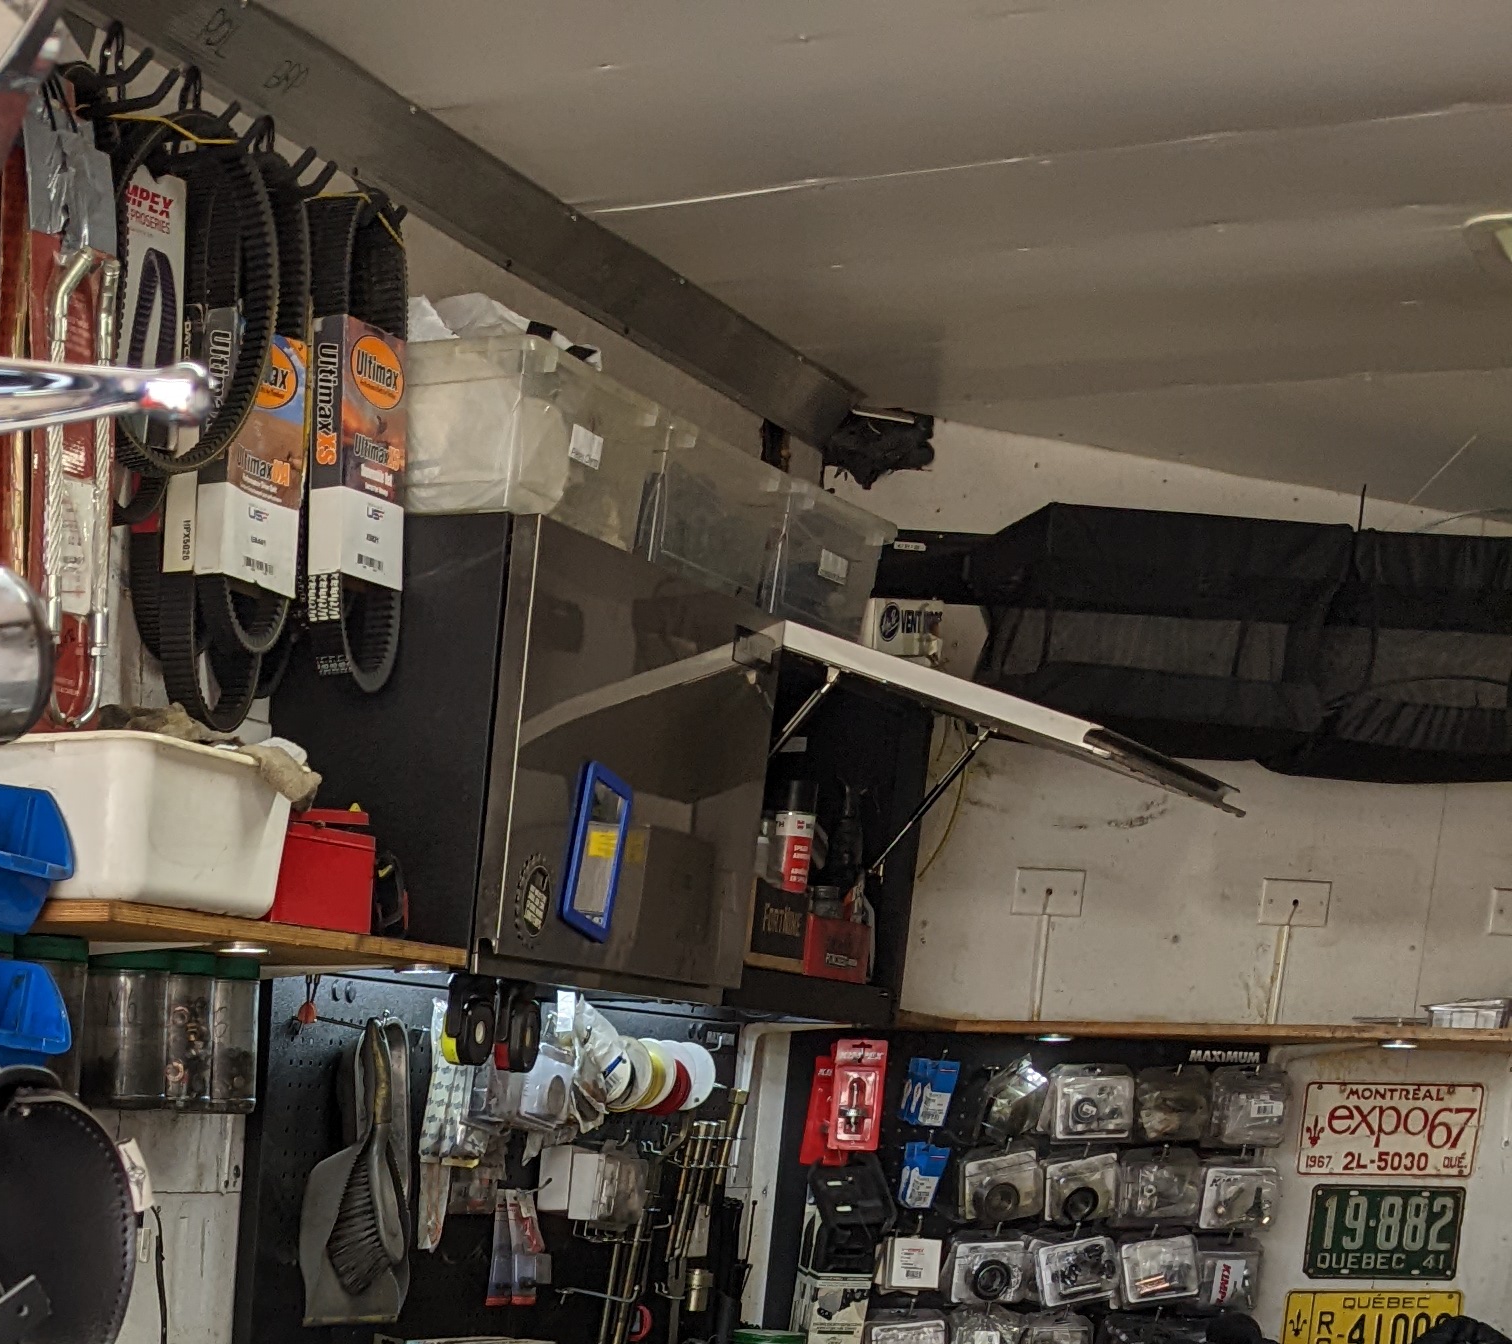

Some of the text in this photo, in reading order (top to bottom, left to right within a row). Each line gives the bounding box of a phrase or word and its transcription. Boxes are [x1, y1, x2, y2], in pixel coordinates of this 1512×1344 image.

[126, 181, 174, 219] MPEX
[183, 320, 192, 362] DAYC
[356, 346, 400, 392] Ultimax
[1188, 1049, 1261, 1064] MAXIMUM
[1326, 1104, 1478, 1150] expo67
[1305, 1154, 1333, 1169] 1967
[1342, 1151, 1429, 1172] 2L-5030
[1316, 1252, 1445, 1270] QUEBEC 41
